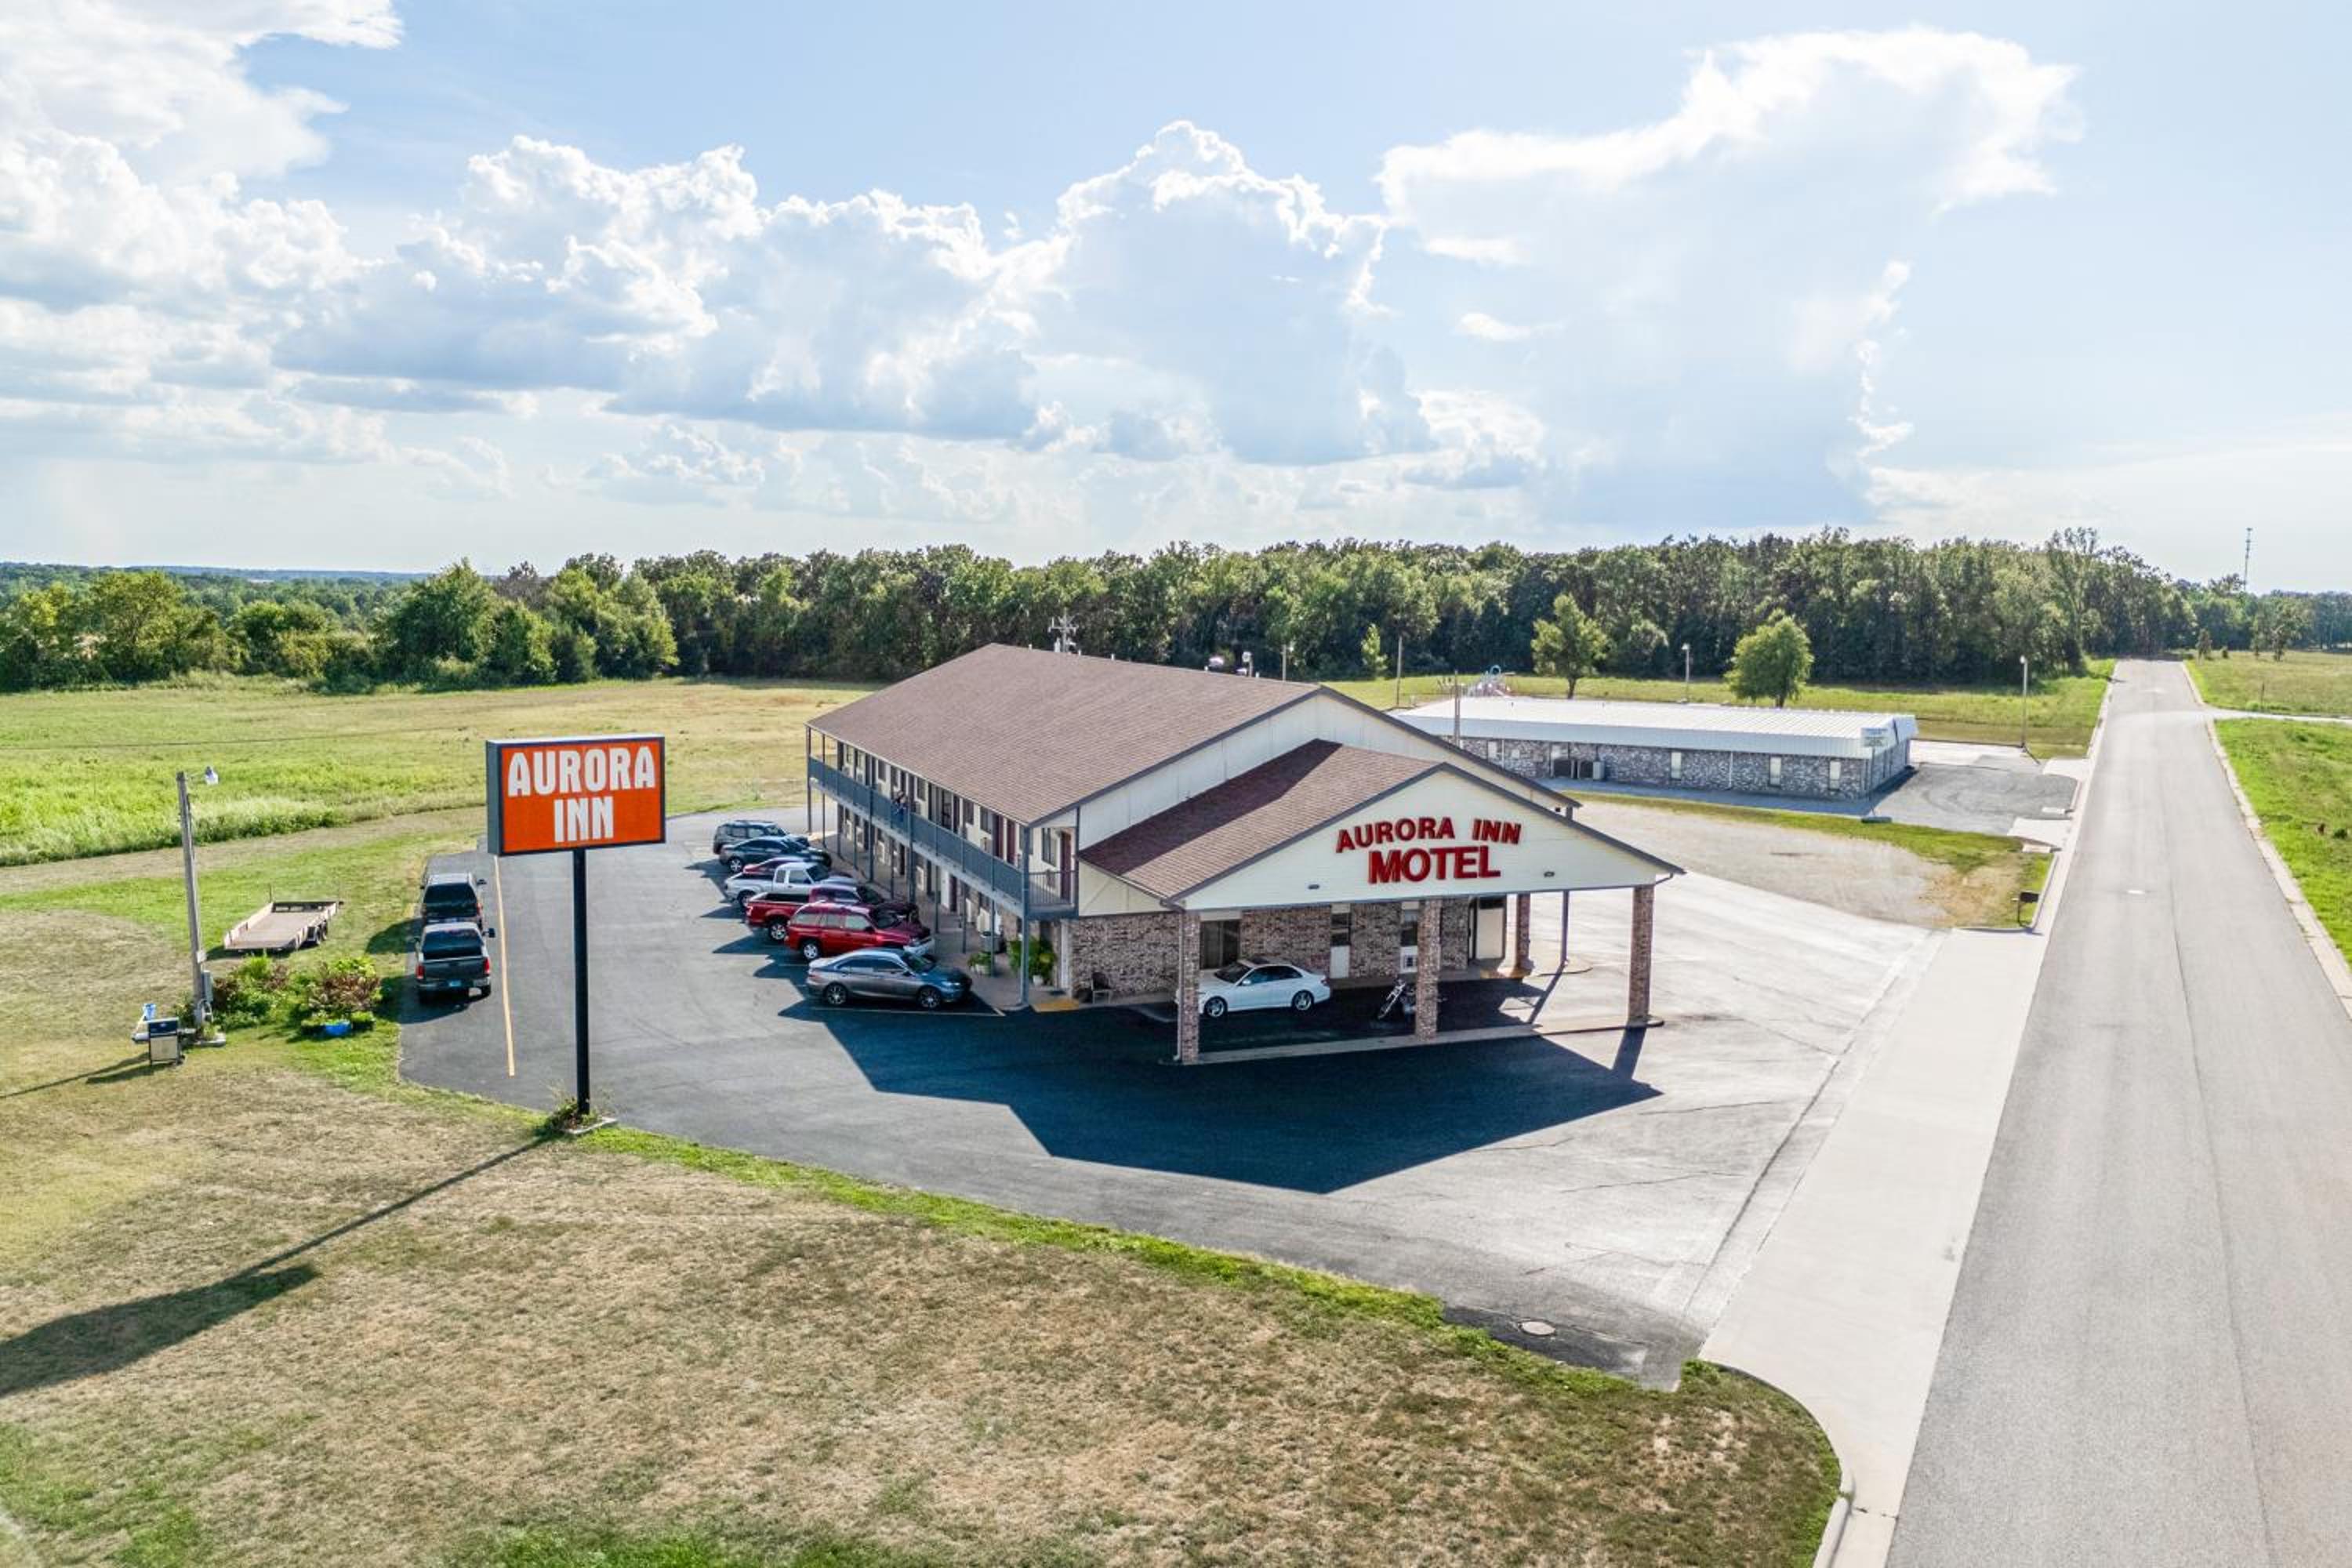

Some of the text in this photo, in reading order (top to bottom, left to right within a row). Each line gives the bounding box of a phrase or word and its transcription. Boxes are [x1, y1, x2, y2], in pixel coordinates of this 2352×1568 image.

[508, 746, 655, 797] AURORA
[554, 797, 614, 843] INN
[1336, 817, 1522, 852] AURORA INN
[1367, 845, 1501, 884] MOTEL
